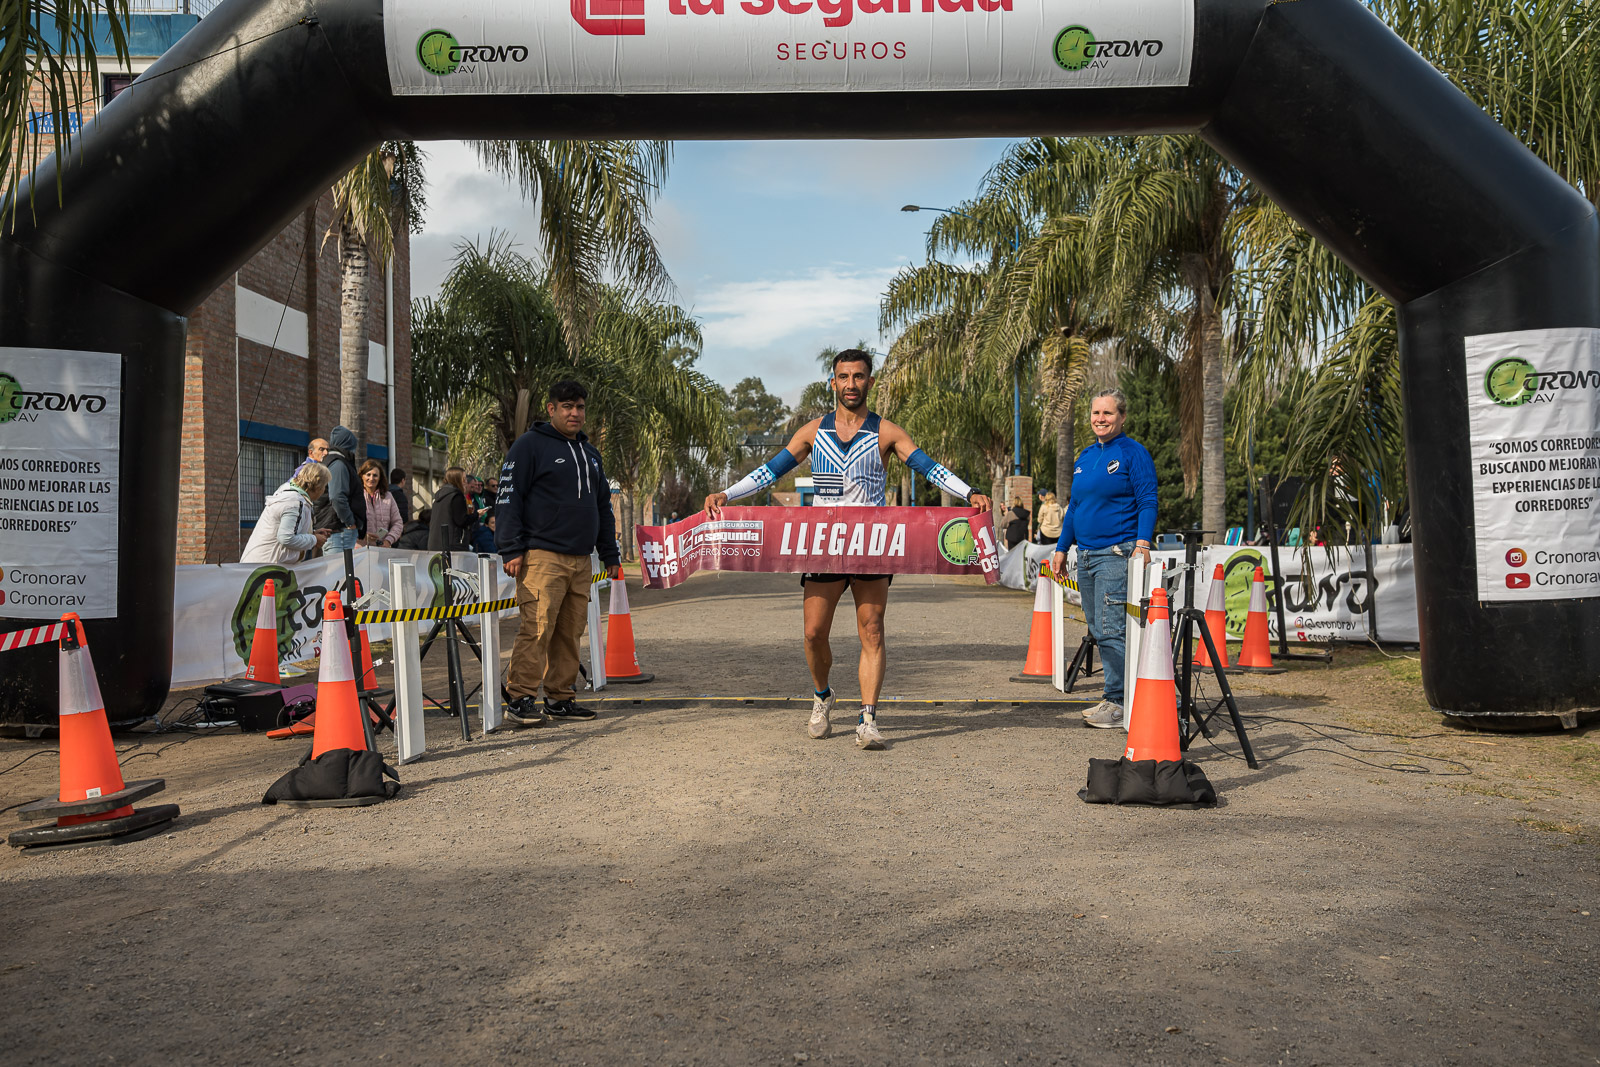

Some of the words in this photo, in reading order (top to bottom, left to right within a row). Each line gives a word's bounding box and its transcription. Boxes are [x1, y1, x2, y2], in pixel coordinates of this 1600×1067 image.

[448, 45, 529, 63] CRONO
[776, 41, 907, 61] SEGUROS
[1083, 39, 1163, 58] CRONO
[448, 65, 476, 74] RAV
[1080, 60, 1109, 70] RAV
[10, 391, 107, 413] CRONO
[1521, 393, 1555, 404] RAV
[8, 412, 39, 423] RAV
[21, 459, 101, 474] CORREDORES
[1480, 460, 1546, 475] BUSCANDO
[1549, 457, 1597, 472] MEJORAR
[0, 478, 25, 491] NDO
[28, 479, 86, 493] MEJORAR
[89, 482, 111, 494] LAS
[1492, 478, 1576, 494] EXPERIENCIAS
[1578, 477, 1591, 490] DE
[58, 500, 74, 513] DE
[77, 501, 99, 513] LOS
[704, 530, 759, 542] segunda
[779, 522, 906, 557] LLEGADA
[642, 534, 678, 562] #1
[681, 558, 689, 568] LO
[688, 547, 720, 562] PRIMERO
[721, 547, 740, 556] SOS
[741, 548, 761, 557] VOS
[10, 569, 87, 585] Cronorav
[9, 590, 86, 606] Cronorav
